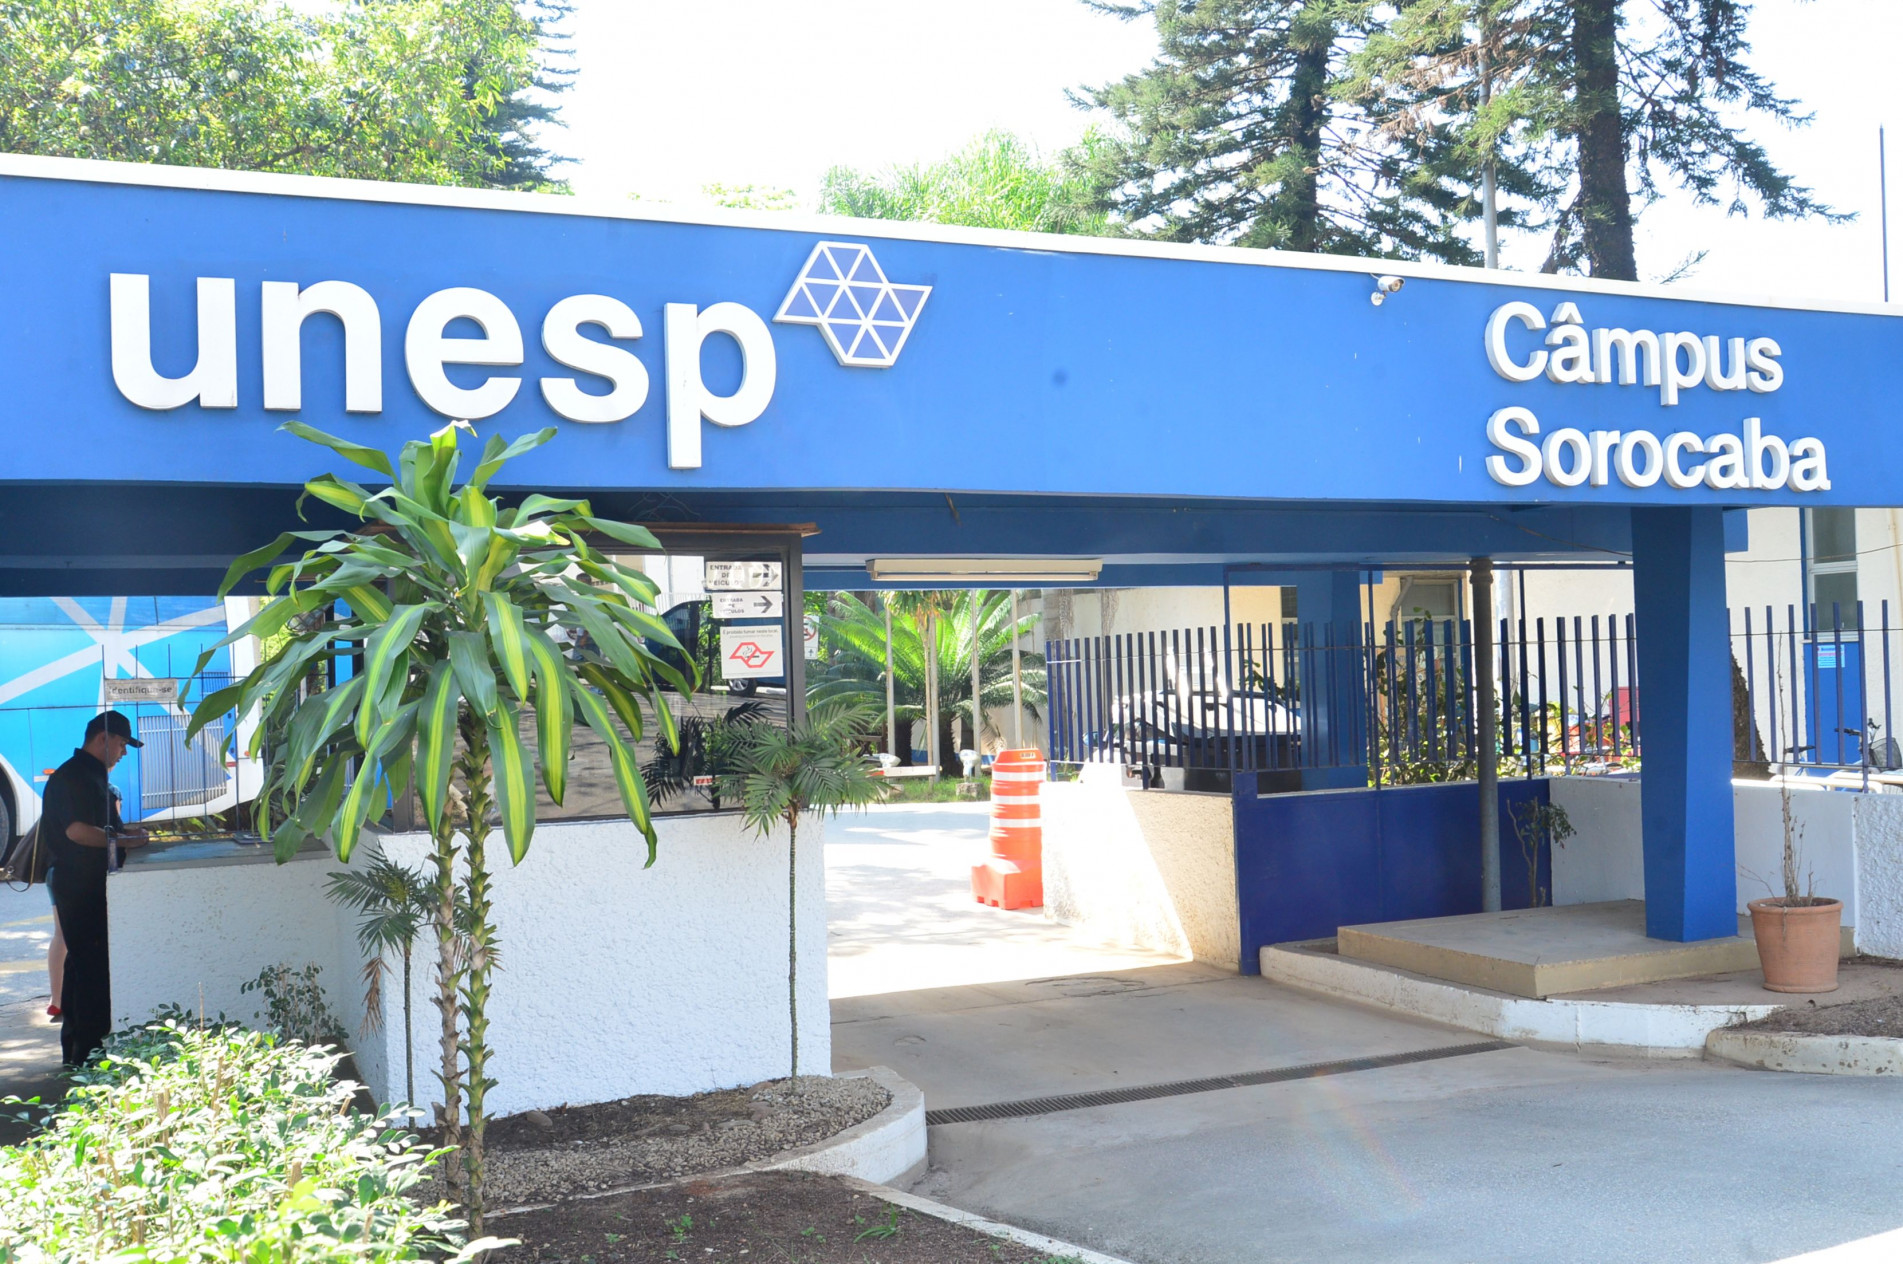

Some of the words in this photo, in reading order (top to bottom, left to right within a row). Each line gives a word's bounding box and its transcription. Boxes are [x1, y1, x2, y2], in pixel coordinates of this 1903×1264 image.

[110, 273, 777, 470] unesp
[1484, 301, 1784, 406] Câmpus
[1485, 406, 1832, 492] Sorocaba
